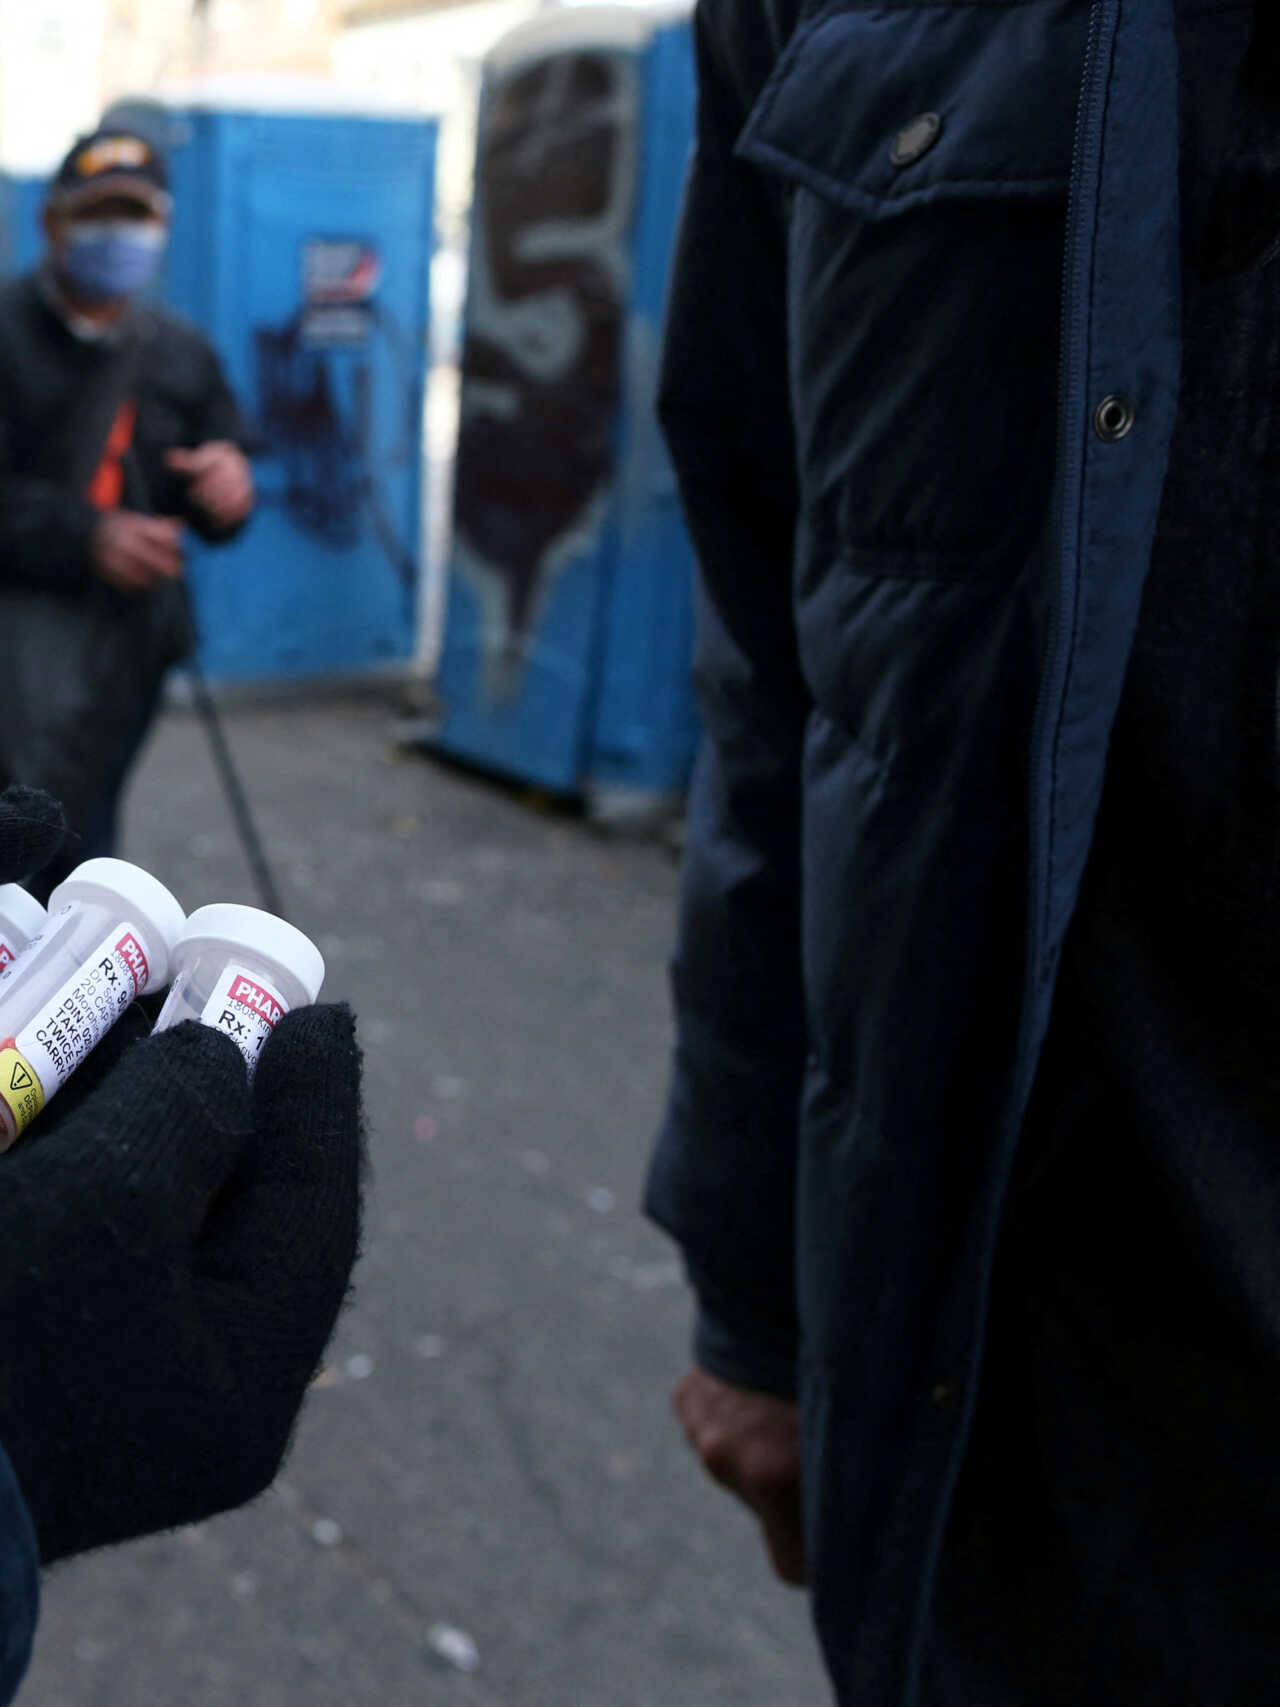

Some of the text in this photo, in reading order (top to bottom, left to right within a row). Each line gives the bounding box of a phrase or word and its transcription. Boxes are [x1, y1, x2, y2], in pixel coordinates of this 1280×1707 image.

[80, 978, 97, 996] 20
[98, 957, 122, 991] Rx:
[63, 998, 84, 1028] DIN:
[218, 1009, 251, 1039] Rx:
[226, 997, 257, 1020] 1808
[46, 1017, 74, 1064] TWICE
[55, 1007, 82, 1048] TAKE
[36, 1029, 66, 1077] CARRY
